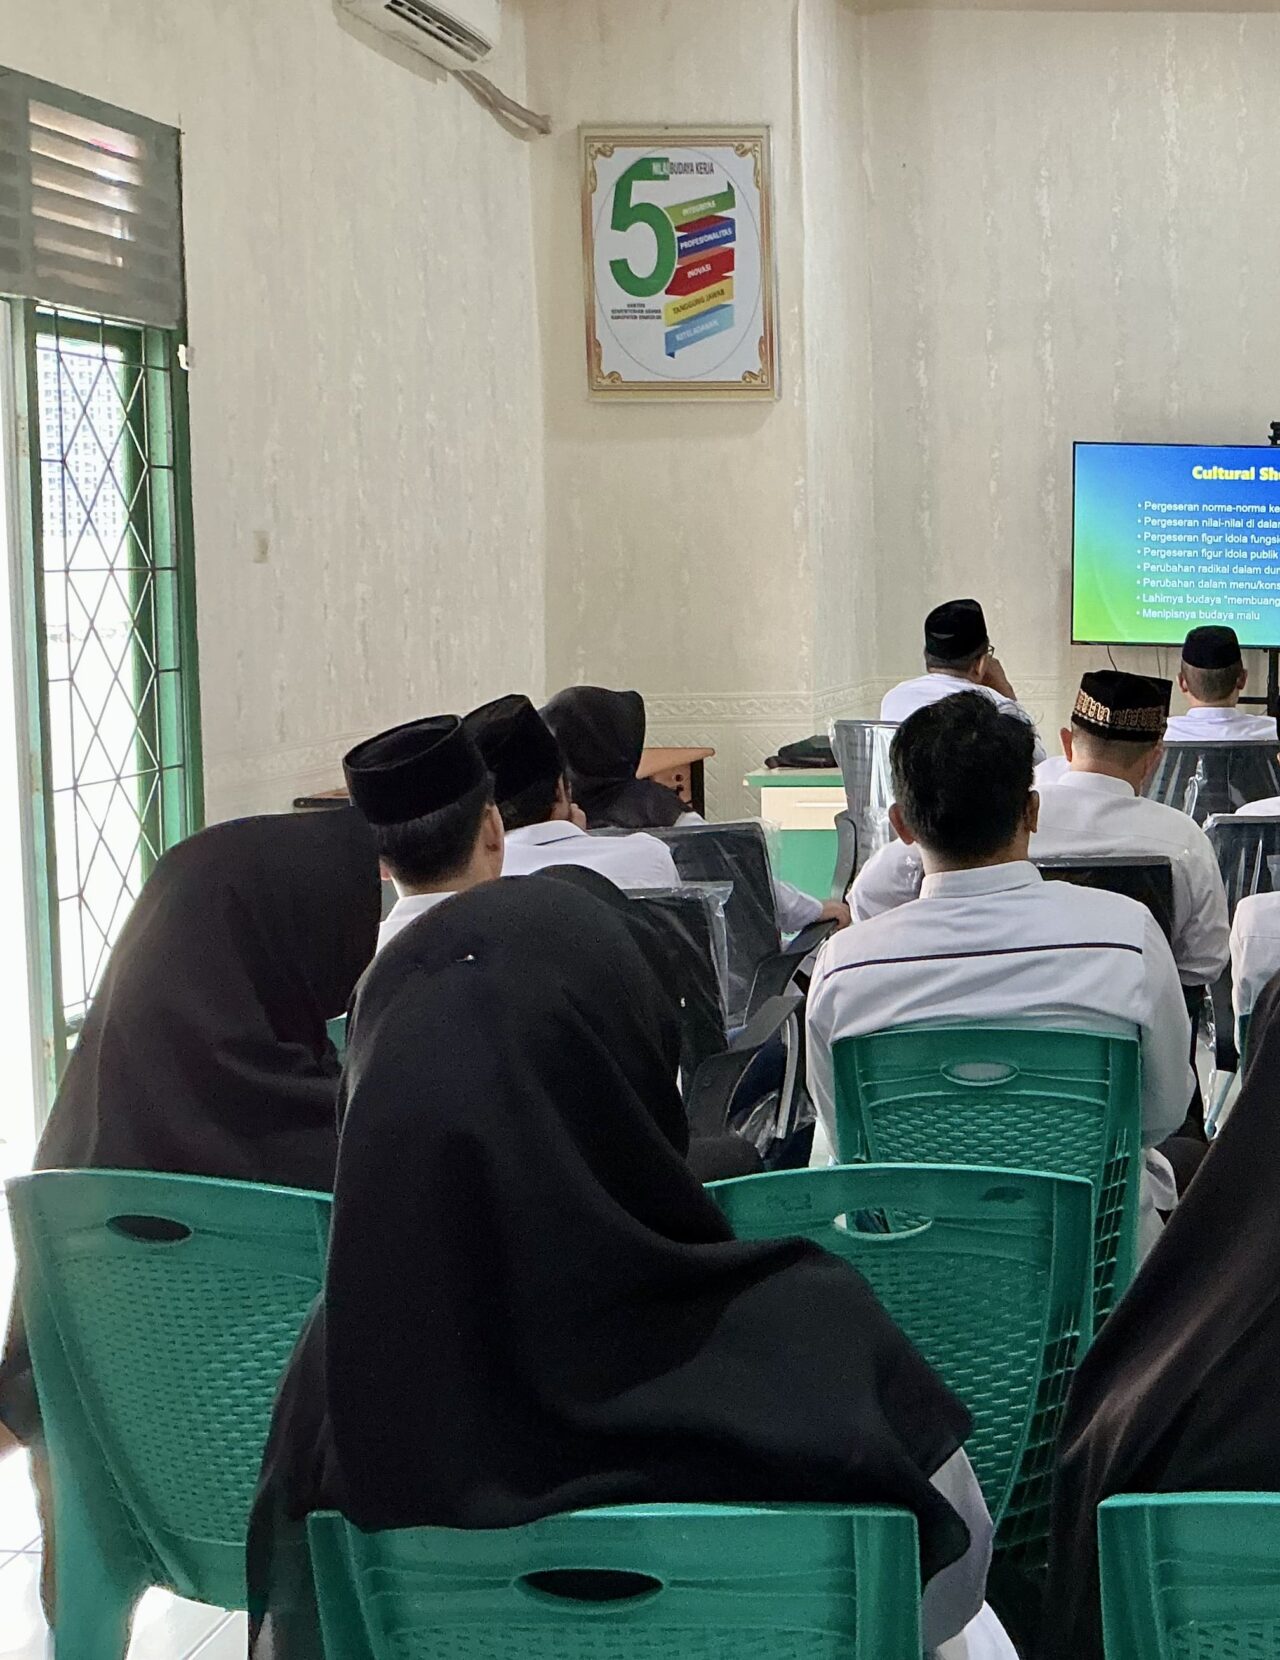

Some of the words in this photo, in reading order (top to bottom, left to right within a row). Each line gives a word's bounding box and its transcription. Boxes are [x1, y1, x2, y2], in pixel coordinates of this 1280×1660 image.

[669, 162, 694, 175] BUDAYA
[695, 162, 714, 175] KERJA
[680, 227, 733, 250] PROFESIONALITAS
[687, 263, 712, 279] INOVASI
[1192, 466, 1255, 480] Cultural
[1144, 501, 1199, 513] Pergeseran
[1202, 503, 1266, 513] norma-norma
[1144, 516, 1199, 528] Pergeseran
[1201, 517, 1244, 528] nilai-nilai
[1246, 519, 1255, 528] di
[1143, 531, 1199, 543] Pergeseran
[1201, 533, 1223, 544] figur
[1225, 534, 1248, 543] idola
[1143, 547, 1199, 559] Pergeseran
[1201, 548, 1223, 560] figur
[1225, 549, 1248, 558] idola
[1250, 550, 1279, 560] publik
[1143, 562, 1195, 573] Perubahan
[1198, 564, 1230, 574] radikal
[1232, 565, 1262, 574] dalam
[1143, 578, 1195, 588] Perubahan
[1198, 579, 1227, 589] dalam
[1186, 594, 1222, 606] budaya
[1142, 608, 1197, 621] Menipisnya
[1199, 610, 1234, 621] budaya
[1236, 611, 1260, 620] malu
